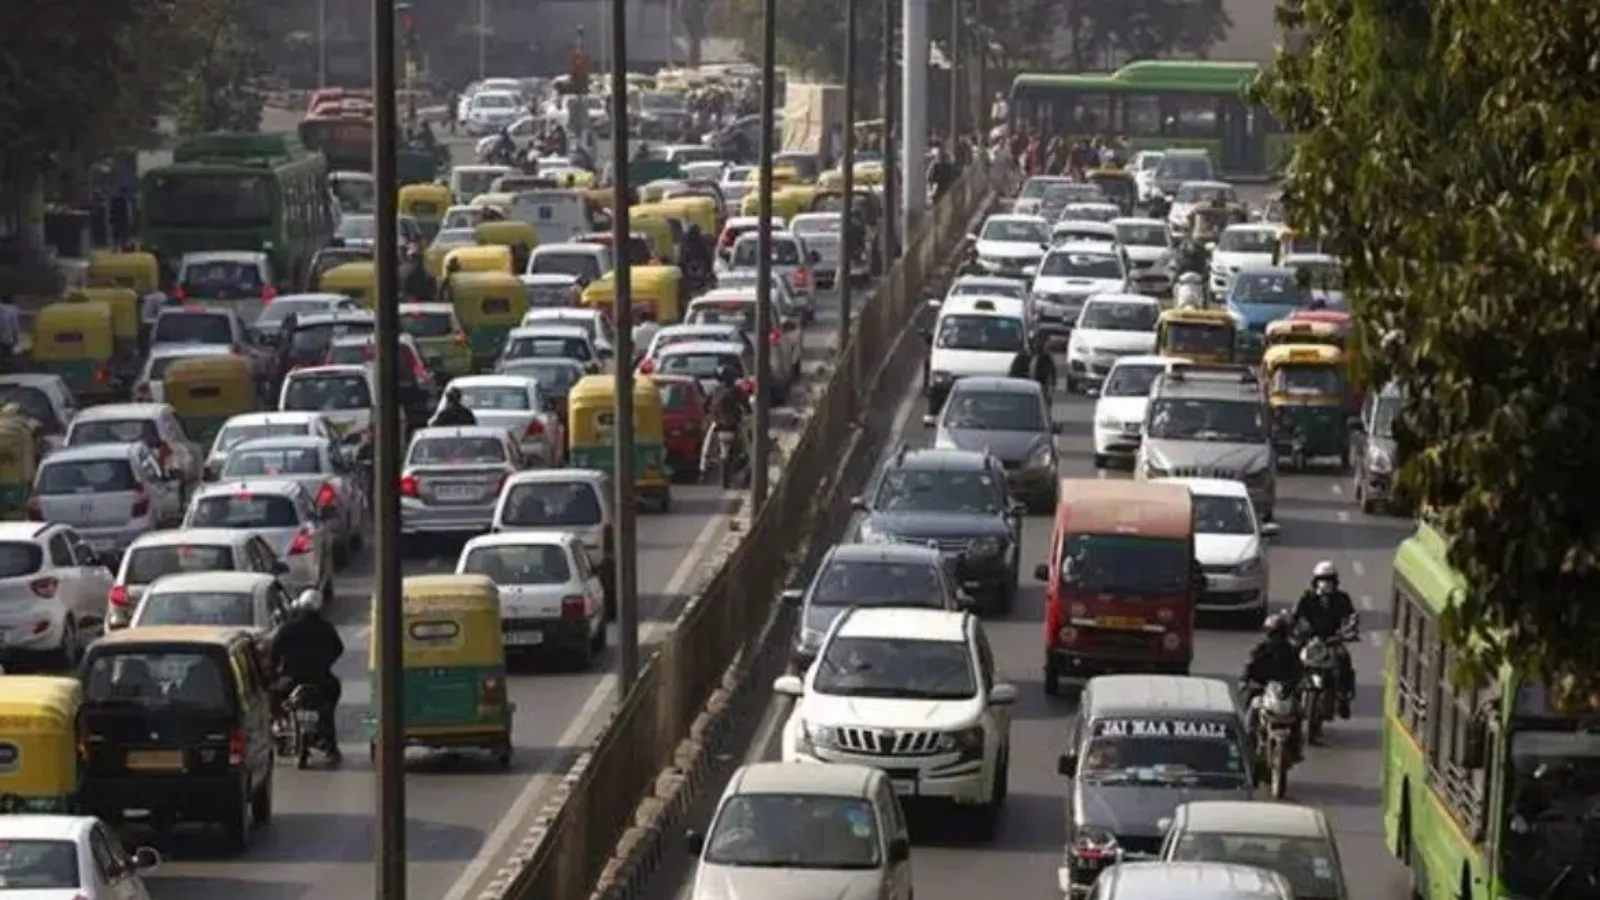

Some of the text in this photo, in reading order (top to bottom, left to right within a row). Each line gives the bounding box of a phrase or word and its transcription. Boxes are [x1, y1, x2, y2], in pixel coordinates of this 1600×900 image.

[1101, 719, 1227, 738] JAI MAA KAALI
